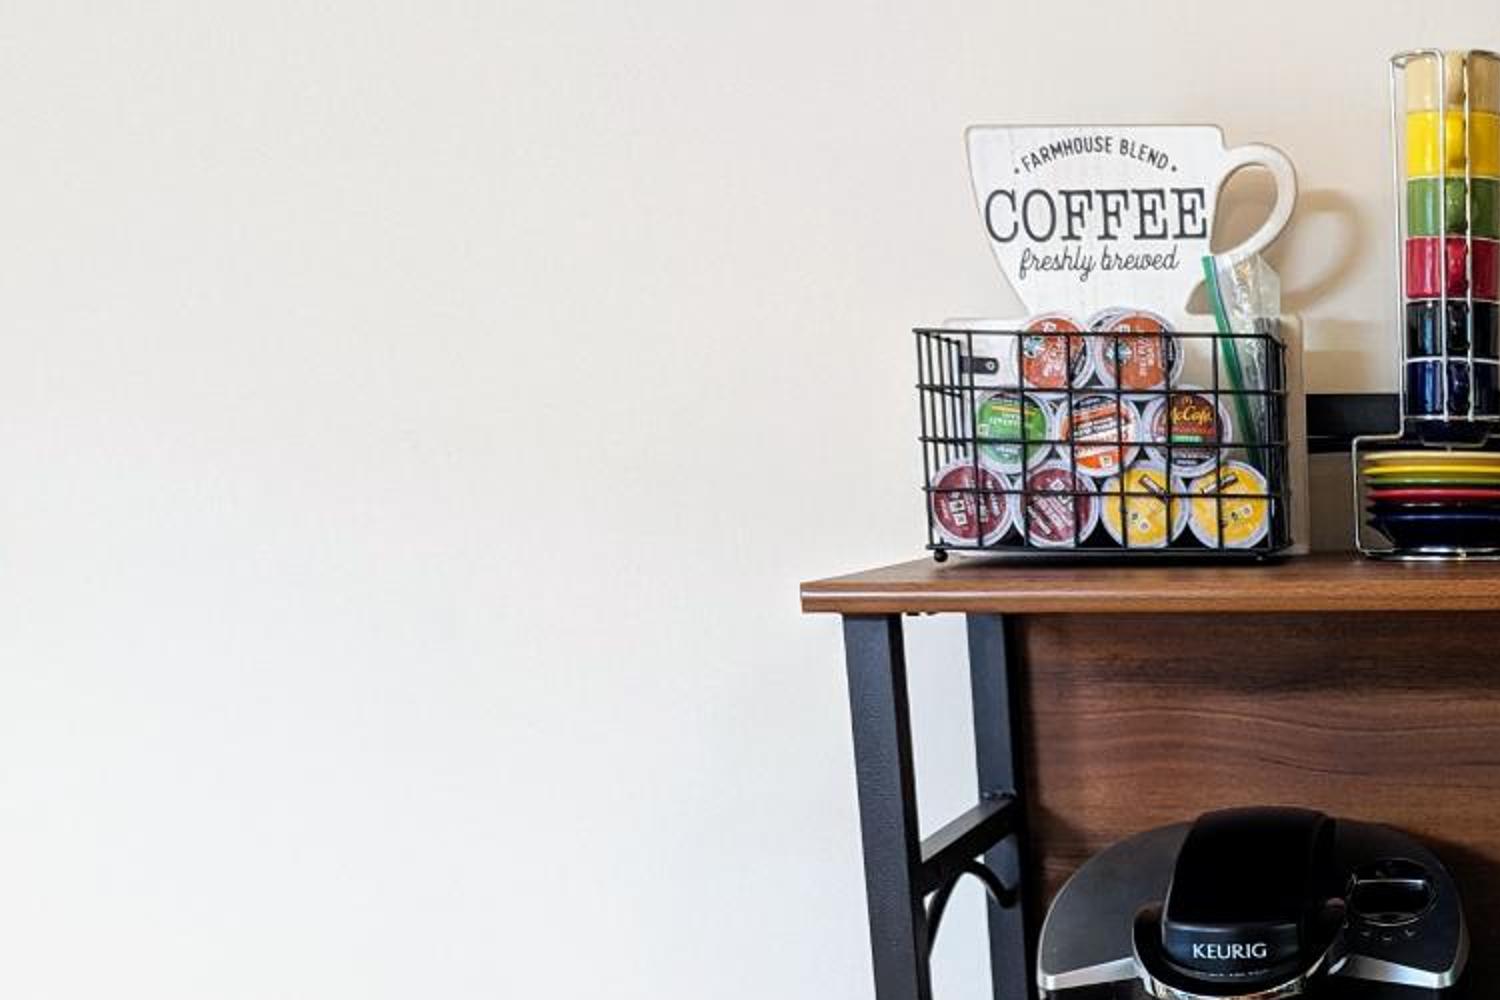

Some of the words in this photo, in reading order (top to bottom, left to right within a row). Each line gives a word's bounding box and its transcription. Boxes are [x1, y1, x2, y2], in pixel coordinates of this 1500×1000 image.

[1021, 136, 1114, 172] FARMHOUSE
[1119, 138, 1169, 170] BLEND
[984, 187, 1208, 243] COFFEE
[1018, 245, 1096, 282] freshly
[1100, 244, 1180, 272] brewed
[1193, 942, 1267, 959] KEURIG
